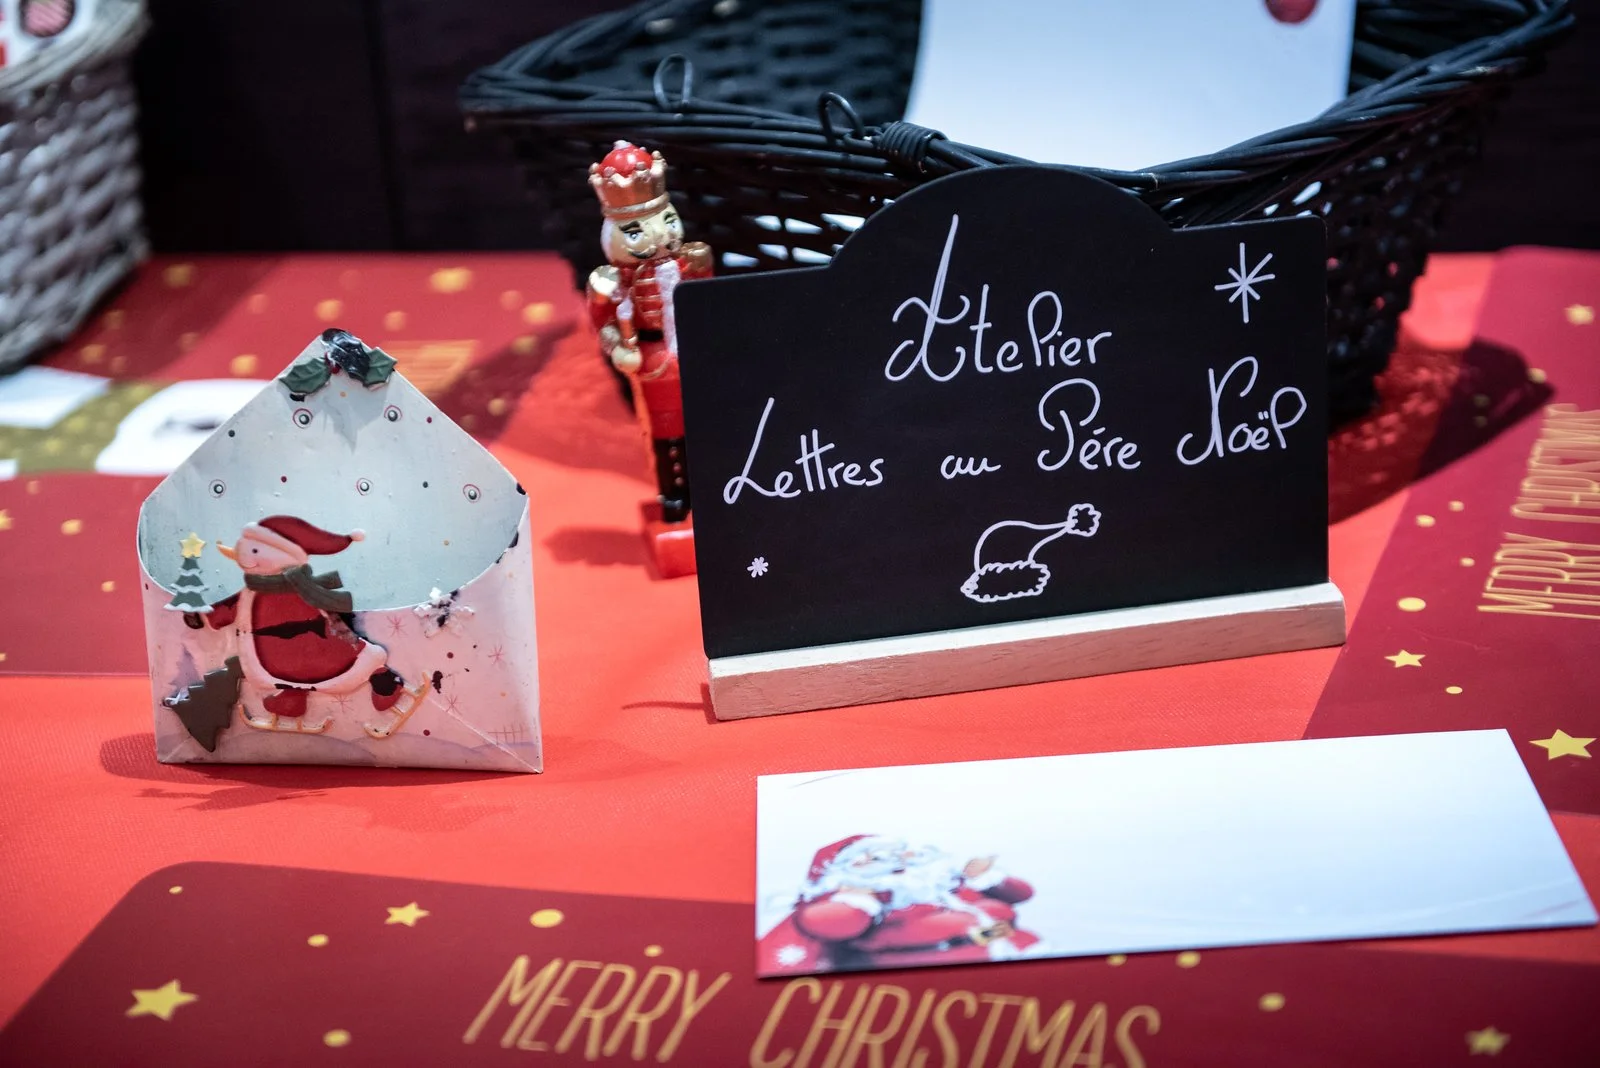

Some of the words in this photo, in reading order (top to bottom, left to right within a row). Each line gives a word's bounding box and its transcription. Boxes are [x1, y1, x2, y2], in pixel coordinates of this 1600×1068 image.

[723, 397, 885, 505] Lettres
[940, 455, 1001, 478] au
[1176, 356, 1308, 465] Noël
[462, 954, 733, 1062] MERRY
[749, 976, 1162, 1068] CHRISTMAS
